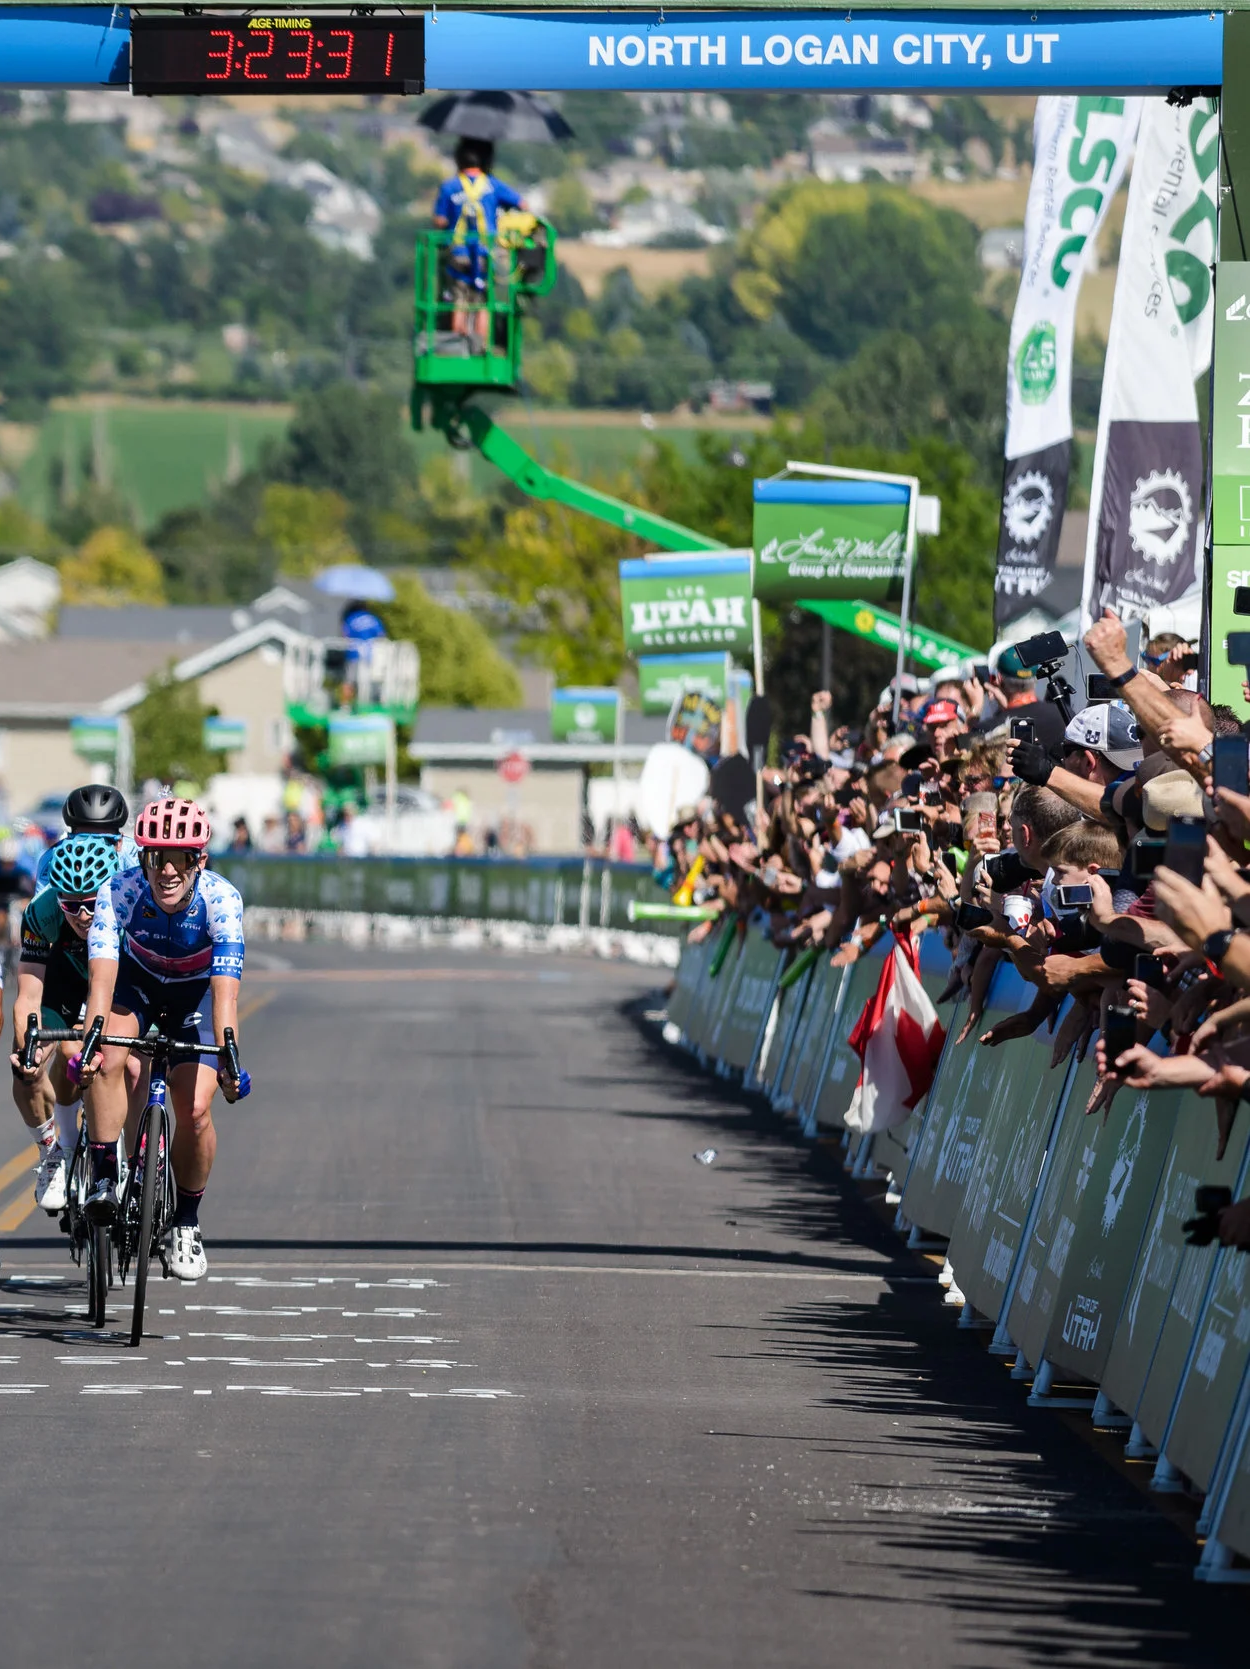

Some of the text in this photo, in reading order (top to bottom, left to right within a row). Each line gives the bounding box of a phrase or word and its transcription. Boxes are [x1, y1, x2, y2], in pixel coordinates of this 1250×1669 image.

[248, 17, 313, 29] ALGE-TIMING
[206, 30, 395, 79] 3:23:31
[588, 33, 1060, 71] NORTH LOGAN CITY, UT
[788, 562, 907, 580] Group of Compani
[630, 596, 748, 634] UTAH
[642, 628, 738, 646] ELEVATED
[212, 956, 244, 969] UTA
[1061, 1301, 1102, 1352] UTAH
